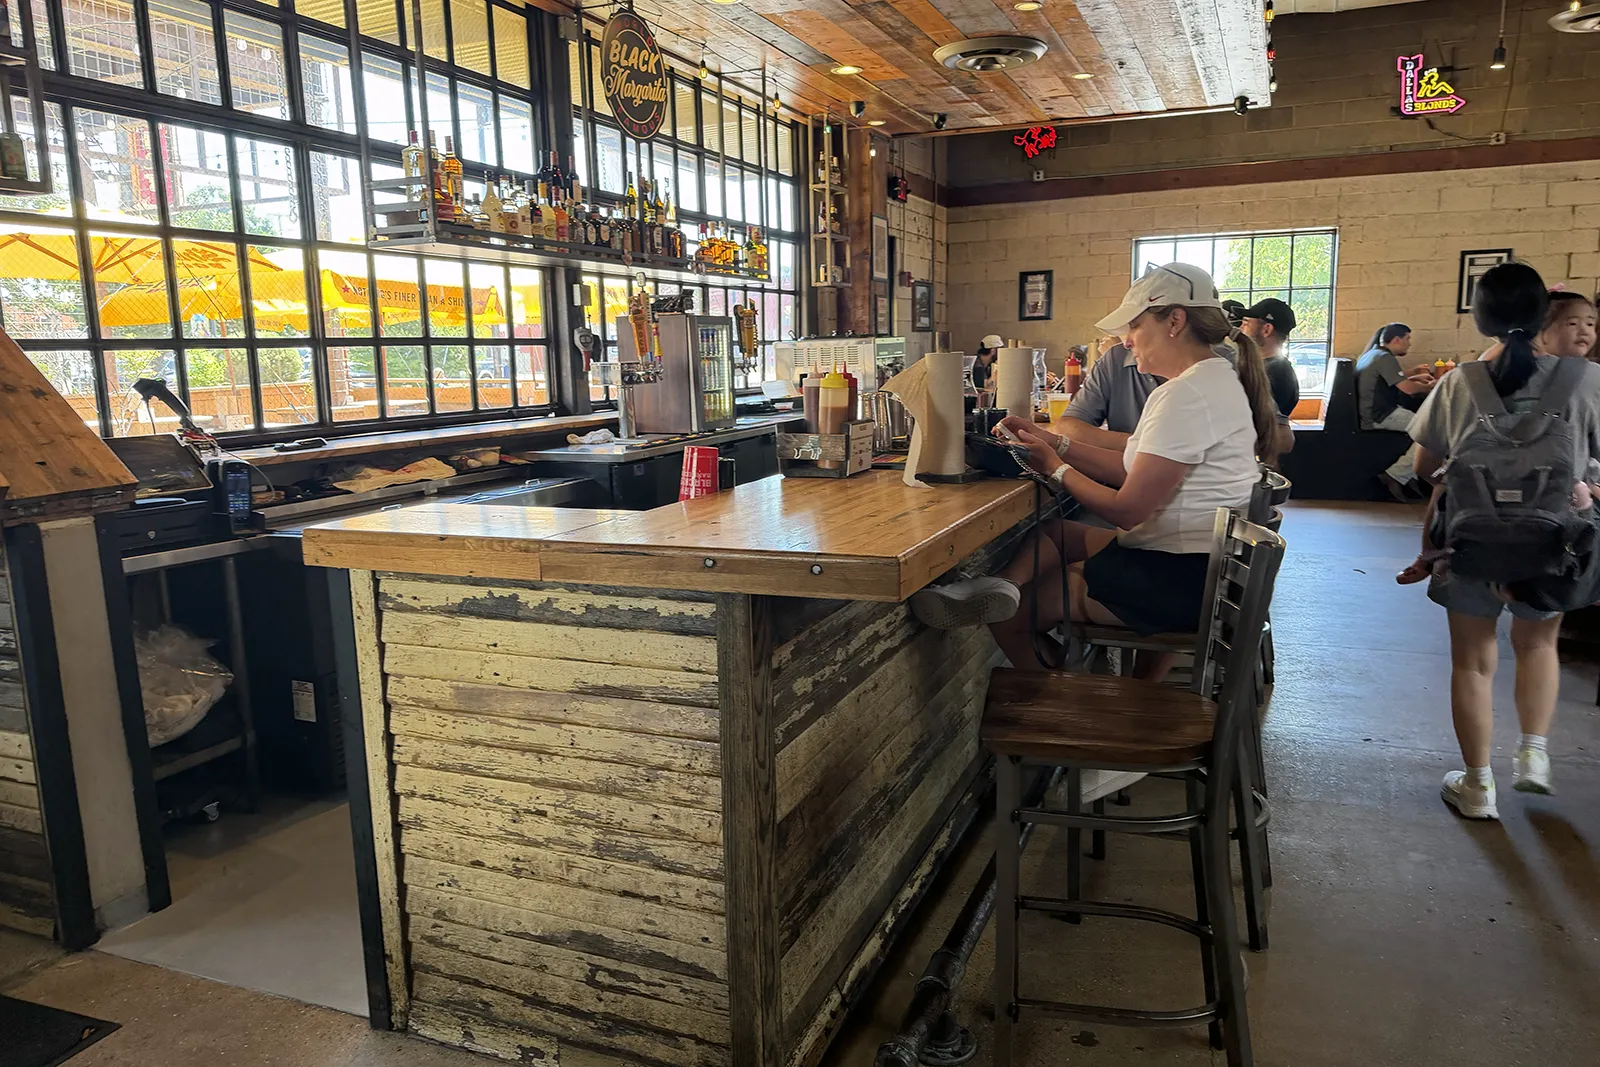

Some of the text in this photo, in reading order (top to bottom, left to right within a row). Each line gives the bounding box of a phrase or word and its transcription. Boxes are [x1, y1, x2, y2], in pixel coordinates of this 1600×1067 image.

[609, 39, 661, 74] BLACK
[604, 63, 666, 108] Margarita
[1404, 61, 1415, 112] DALLAS
[616, 106, 660, 135] FAMOUS
[394, 291, 417, 303] FINER
